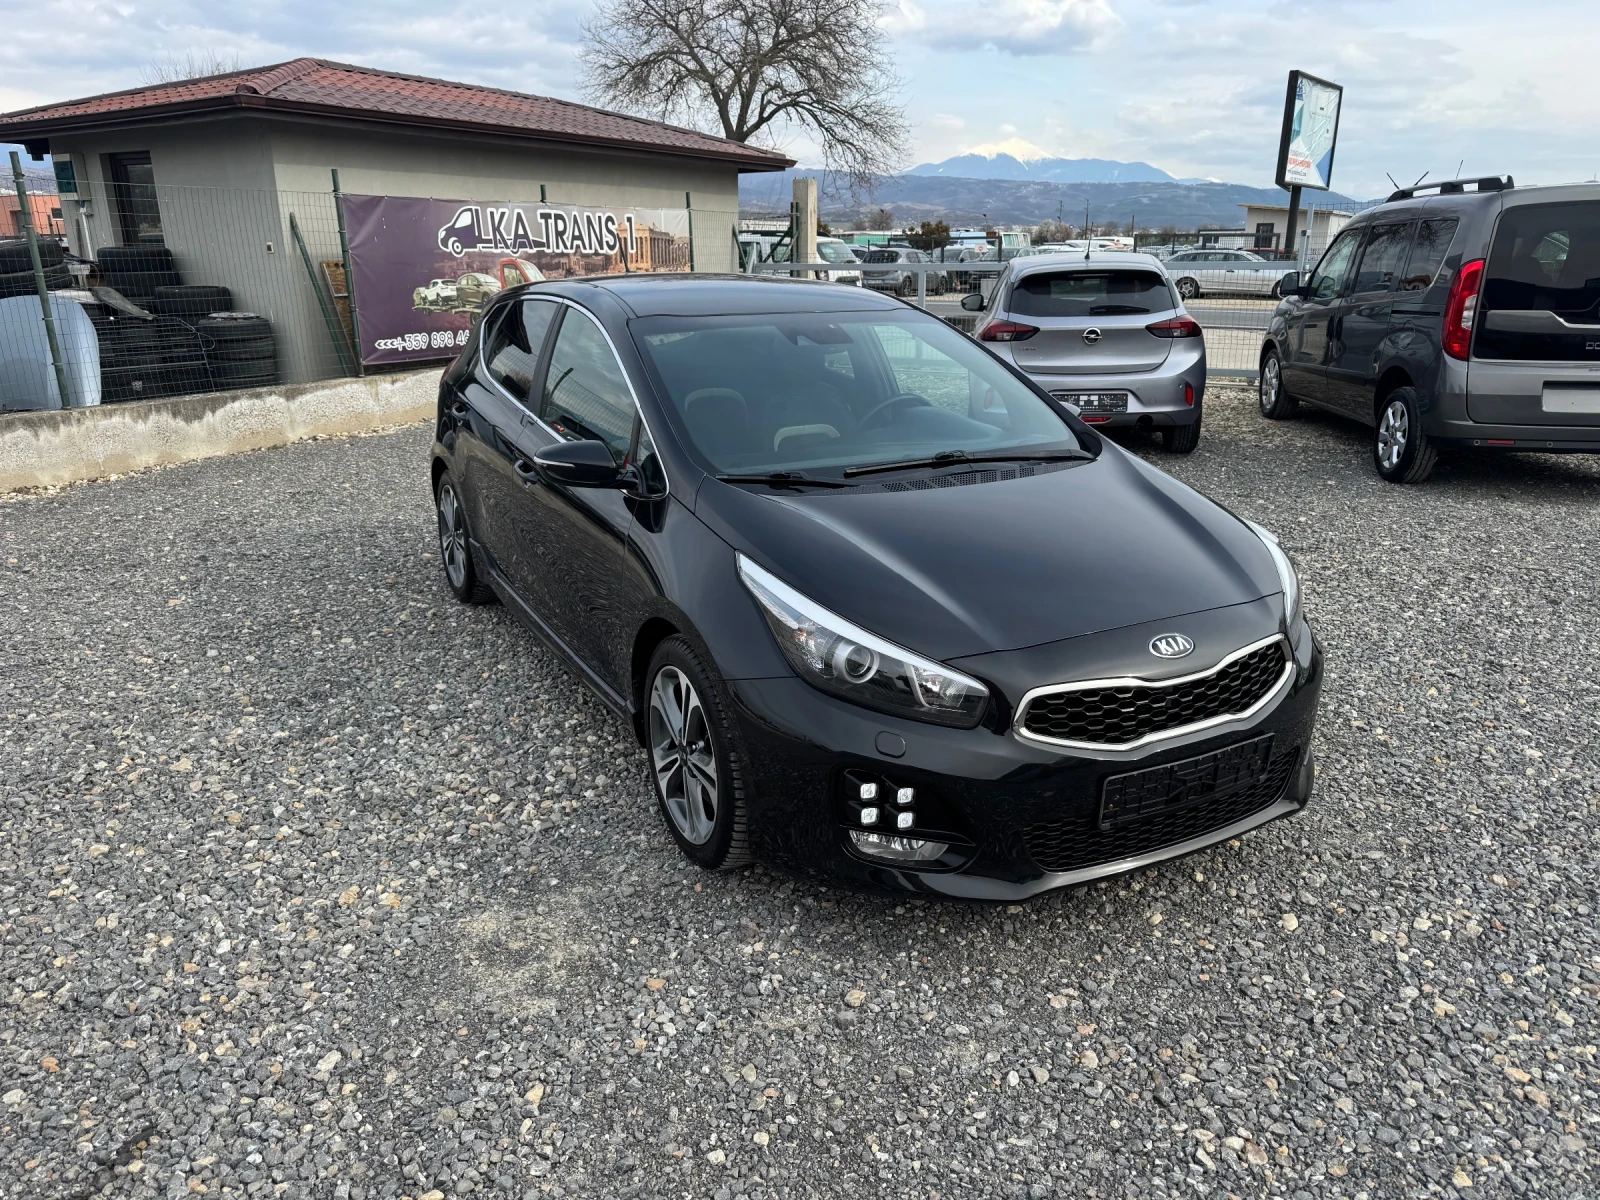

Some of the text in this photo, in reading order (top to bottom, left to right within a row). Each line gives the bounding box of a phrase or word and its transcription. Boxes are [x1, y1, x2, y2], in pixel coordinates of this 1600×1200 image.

[538, 210, 618, 253] TRANS
[625, 214, 636, 253] 1
[431, 331, 454, 348] 898
[1154, 635, 1191, 655] KIA
